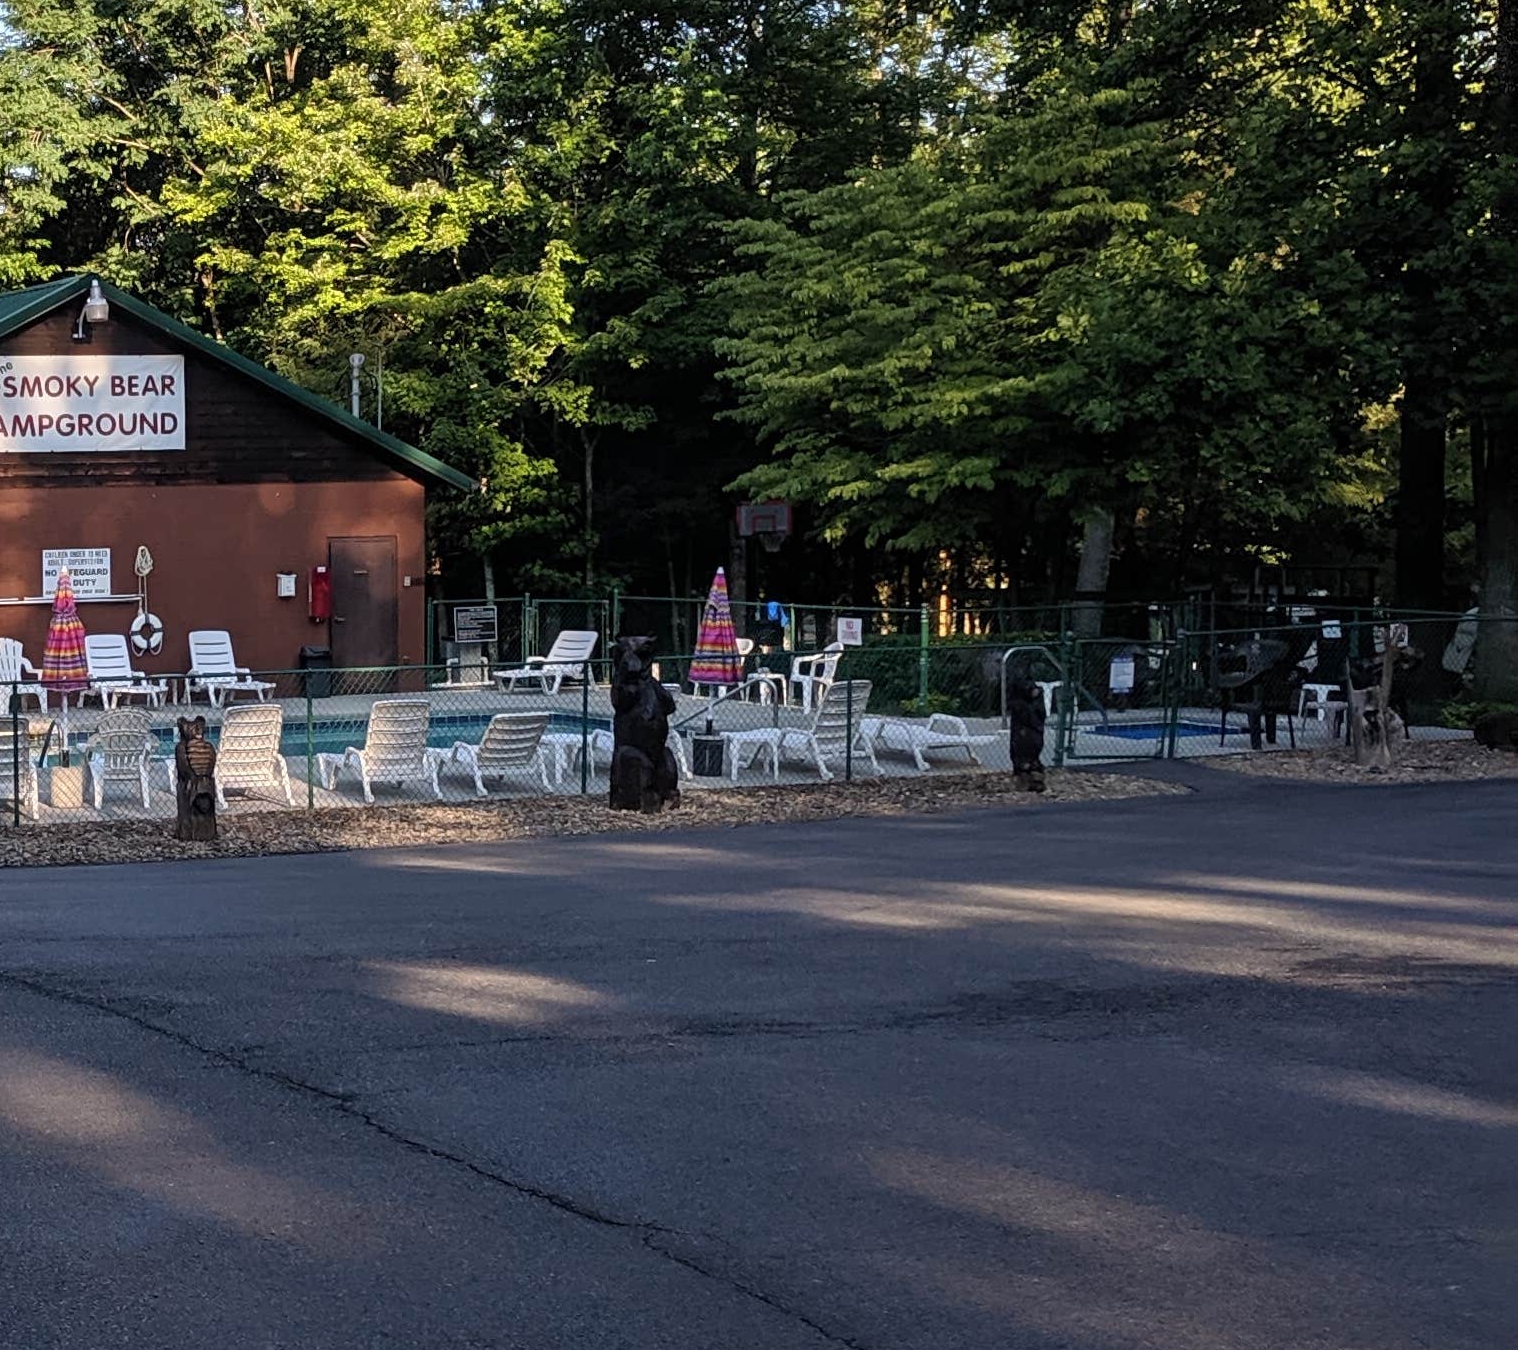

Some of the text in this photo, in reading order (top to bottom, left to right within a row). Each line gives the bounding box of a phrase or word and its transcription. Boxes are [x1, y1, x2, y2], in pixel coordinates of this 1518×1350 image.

[3, 374, 176, 398] SMOKY BEAR
[68, 568, 109, 576] FEGUARD
